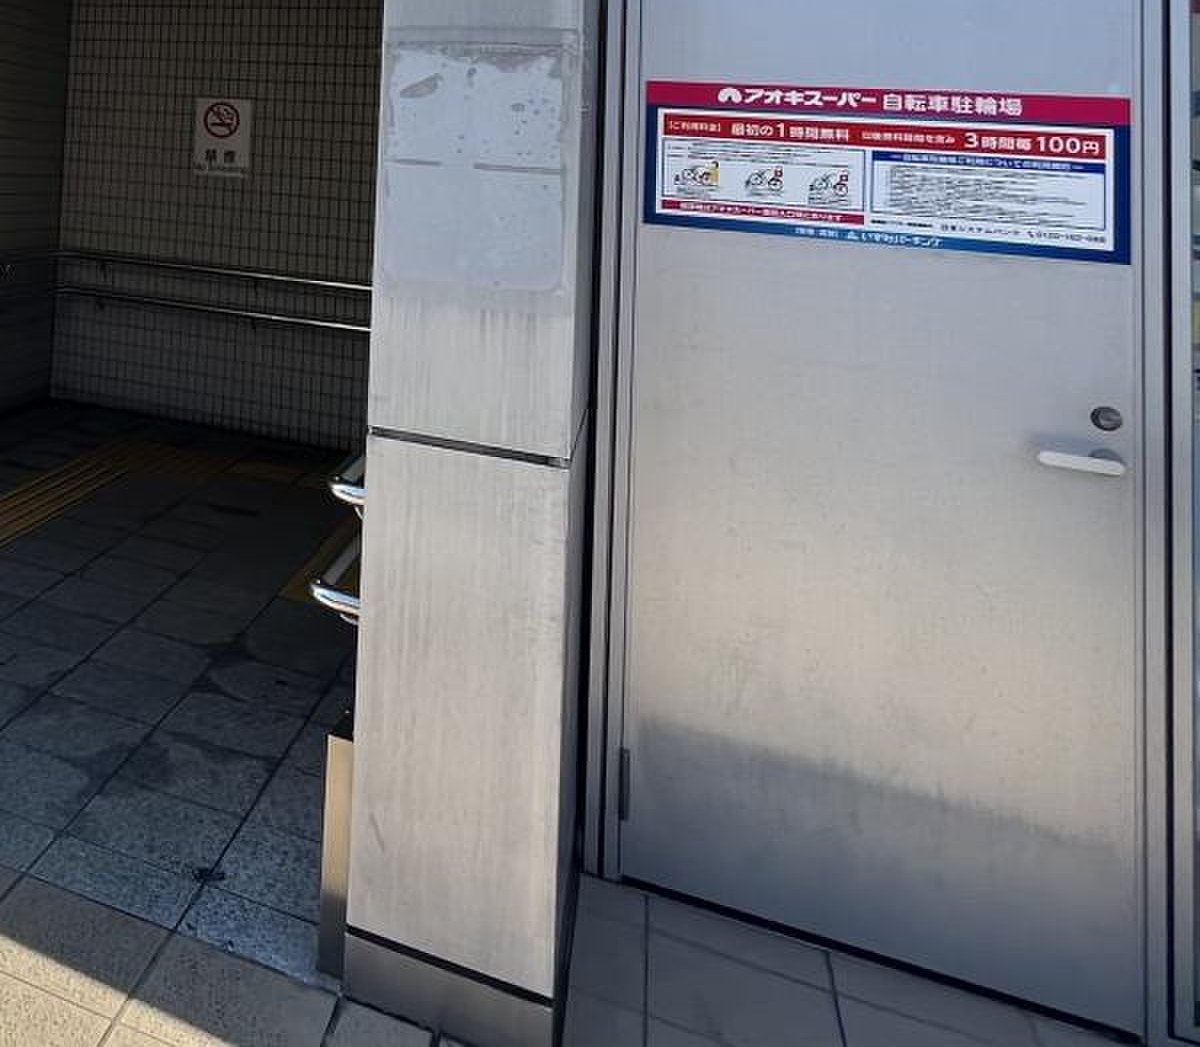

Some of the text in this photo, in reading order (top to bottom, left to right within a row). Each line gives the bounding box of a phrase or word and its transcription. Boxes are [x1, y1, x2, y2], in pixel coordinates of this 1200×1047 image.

[744, 89, 1023, 116] アオキスーパー 自転車駐輪場
